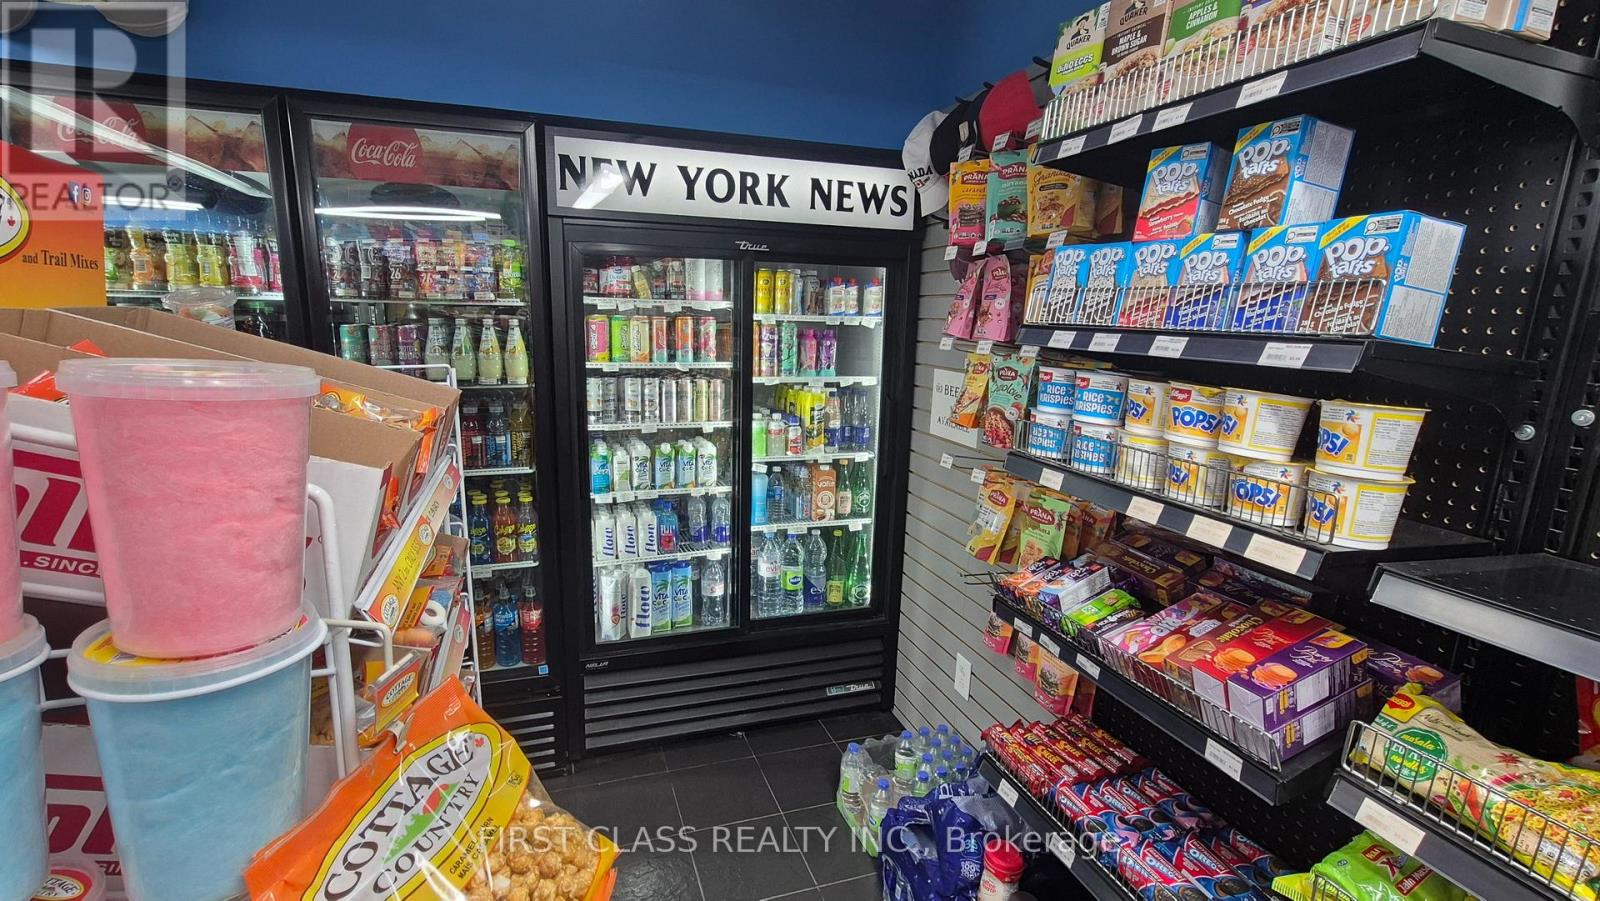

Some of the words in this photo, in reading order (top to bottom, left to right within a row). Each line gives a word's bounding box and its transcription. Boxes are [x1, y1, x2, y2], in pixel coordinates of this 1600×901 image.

[1120, 6, 1148, 26] QUAKER
[1066, 34, 1091, 50] QUAKER
[350, 137, 418, 170] Coca-Cola
[1002, 164, 1028, 176] PRĀN
[676, 165, 791, 210] YORK
[809, 177, 909, 218] NEWS
[734, 240, 770, 252] True
[22, 253, 38, 264] and
[41, 249, 67, 267] Trail
[70, 253, 99, 270] Mixes
[1046, 385, 1067, 396] RICE
[1082, 390, 1105, 403] RICE
[1171, 407, 1220, 434] POPS!
[1029, 507, 1053, 522] PRĀNA
[33, 556, 101, 575] SINC
[674, 588, 688, 596] VITA
[635, 585, 651, 628] flow
[385, 673, 414, 700] COTTAGE
[1402, 734, 1436, 751] masala
[1104, 794, 1128, 813] OREO
[323, 735, 475, 901] COTTAGE
[371, 773, 481, 895] COUNTRY
[471, 824, 501, 860] CAAMEL
[1189, 848, 1218, 870] OREO
